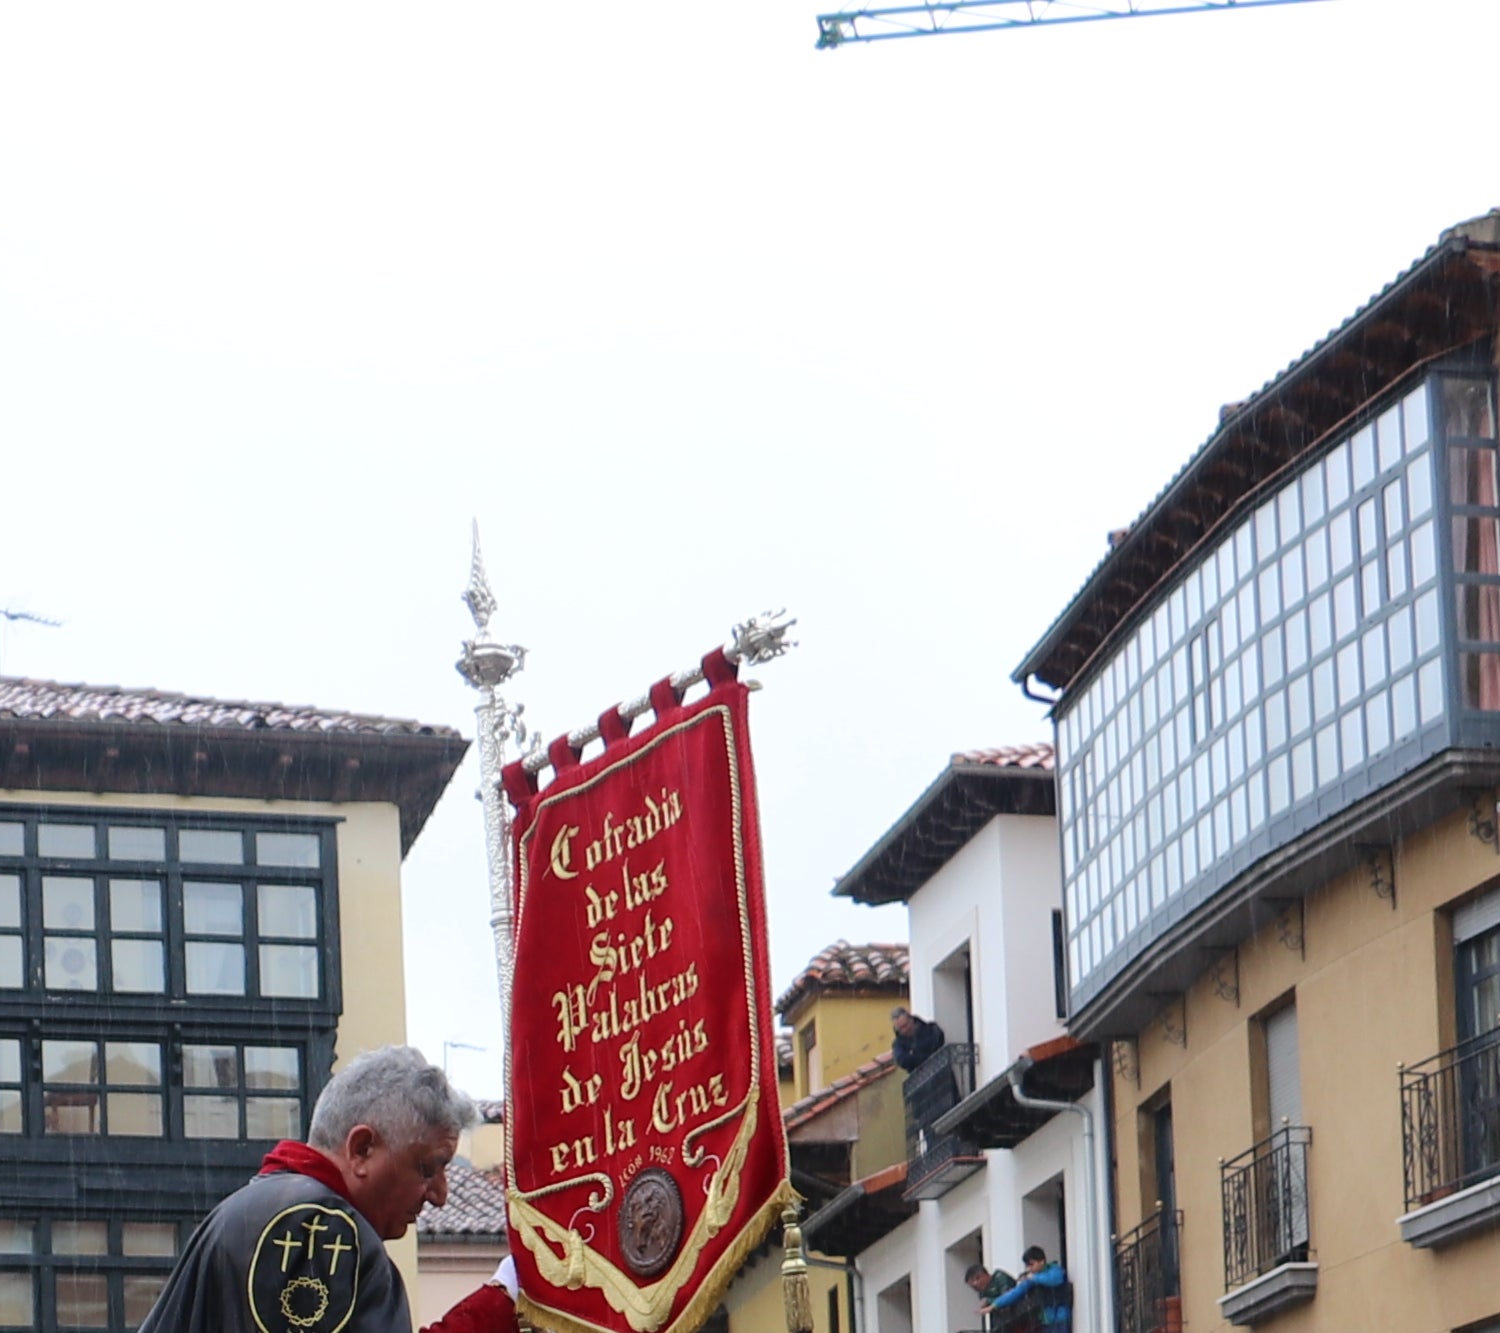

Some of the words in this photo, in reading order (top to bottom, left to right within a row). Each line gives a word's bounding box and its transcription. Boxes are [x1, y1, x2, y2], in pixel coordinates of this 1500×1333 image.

[586, 883, 619, 928] de
[622, 858, 669, 911] las
[587, 908, 673, 1007] Siete
[552, 962, 699, 1053] Palabras
[560, 1065, 602, 1114] de
[619, 1018, 708, 1100] Jesús
[549, 1136, 598, 1175] en
[603, 1104, 637, 1157] la
[646, 1073, 729, 1135] Cruz
[649, 1145, 676, 1165] 1962
